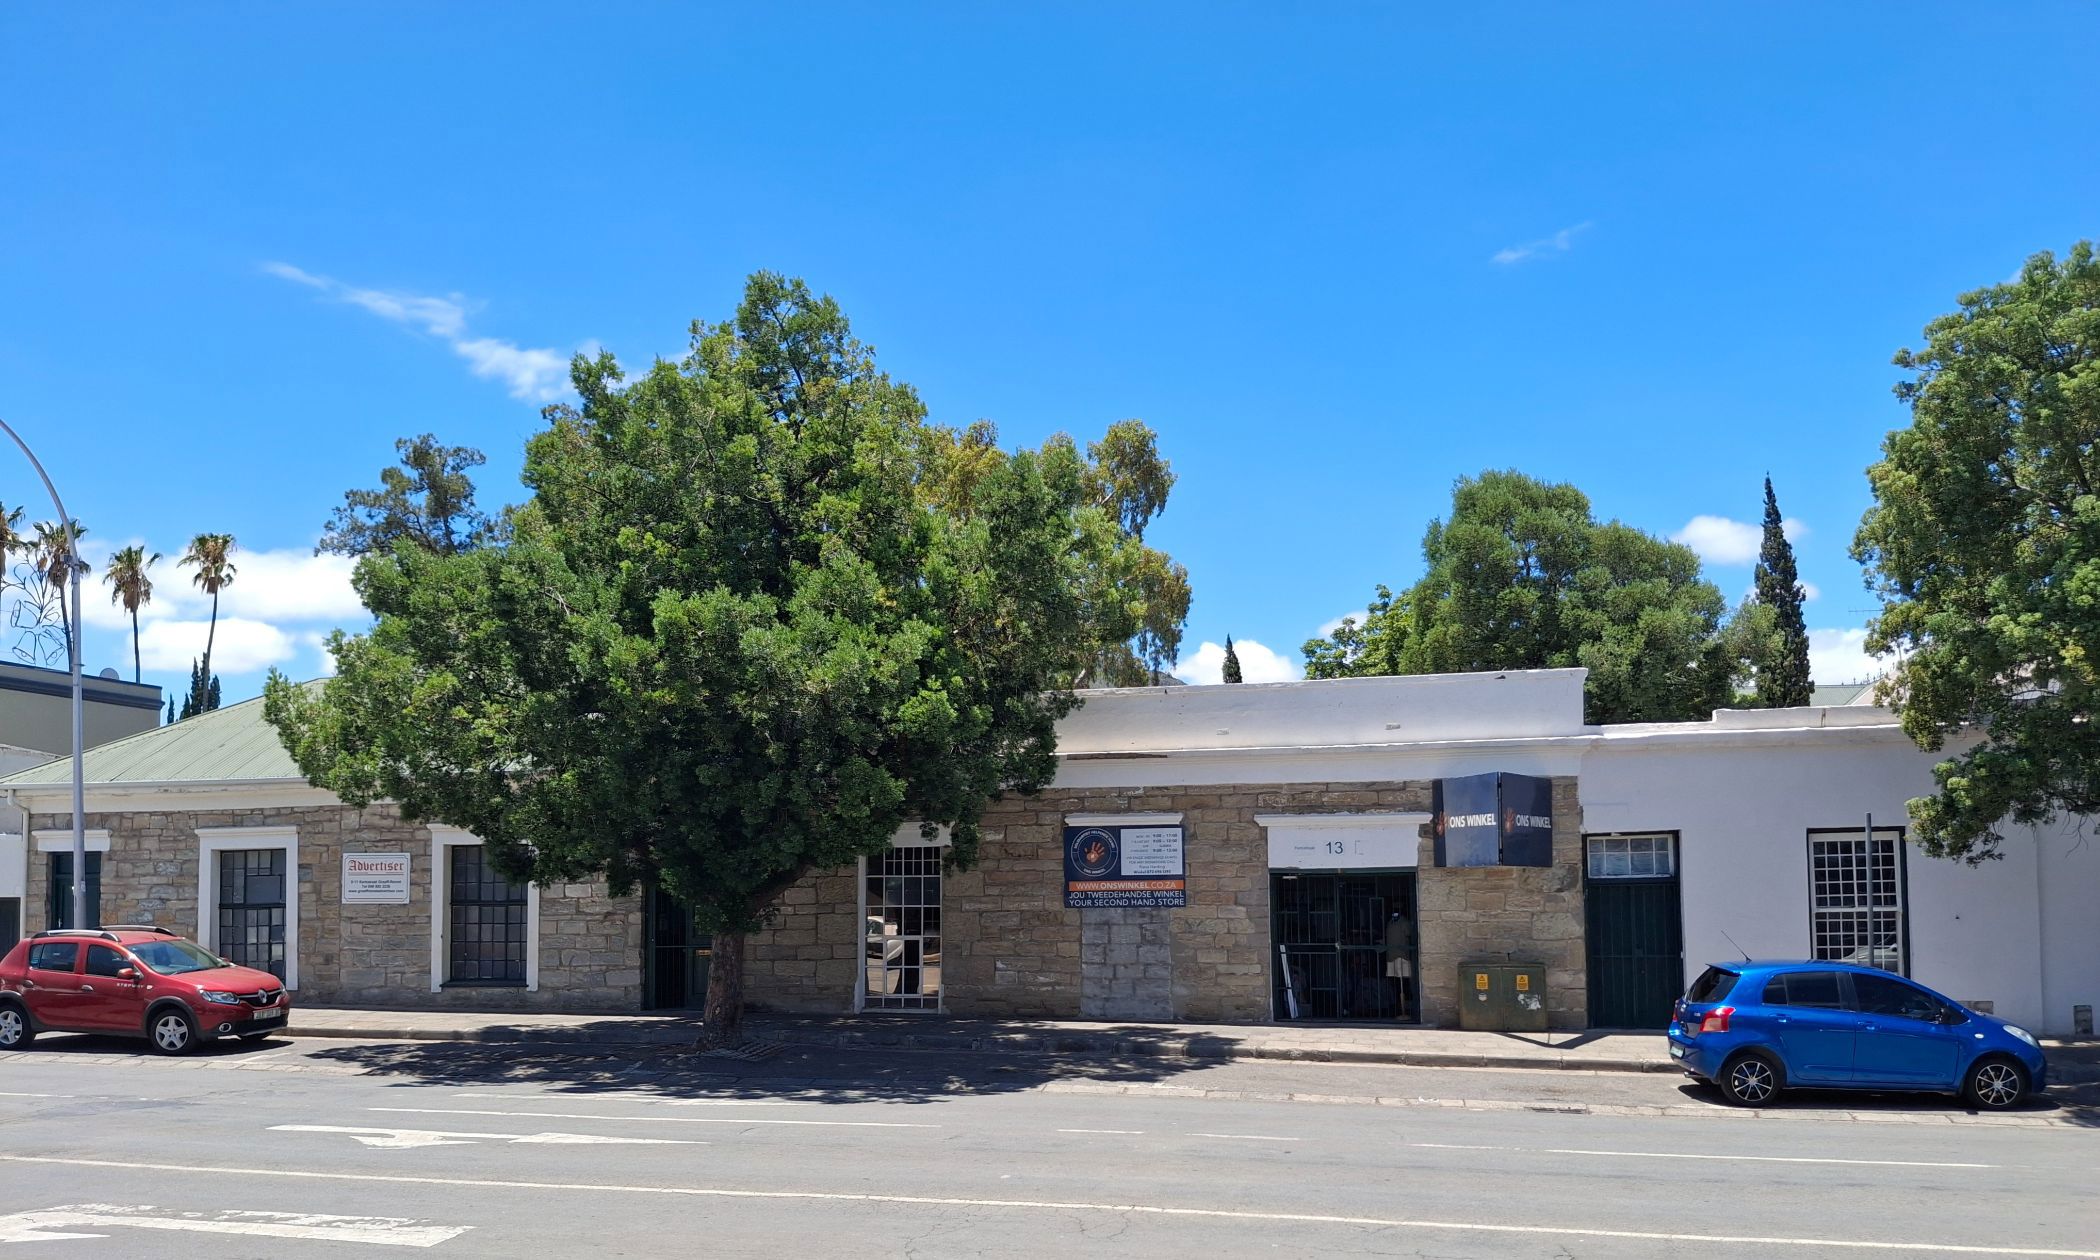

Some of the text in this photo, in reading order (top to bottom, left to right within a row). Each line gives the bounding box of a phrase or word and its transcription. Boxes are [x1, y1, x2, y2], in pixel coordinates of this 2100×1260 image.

[1449, 813, 1496, 828] ONS WINKEL
[1515, 814, 1552, 829] ONS WINKEL
[1326, 841, 1344, 855] 13
[348, 859, 405, 871] Advertiser
[1076, 881, 1177, 889] WWW.ONSWINKEL.CO.ZA
[1069, 890, 1184, 899] JOU TWEEDEHANDSE WINKEL
[1069, 899, 1092, 907] YOUR
[1094, 899, 1129, 907] SECOND
[1157, 898, 1185, 906] STORE
